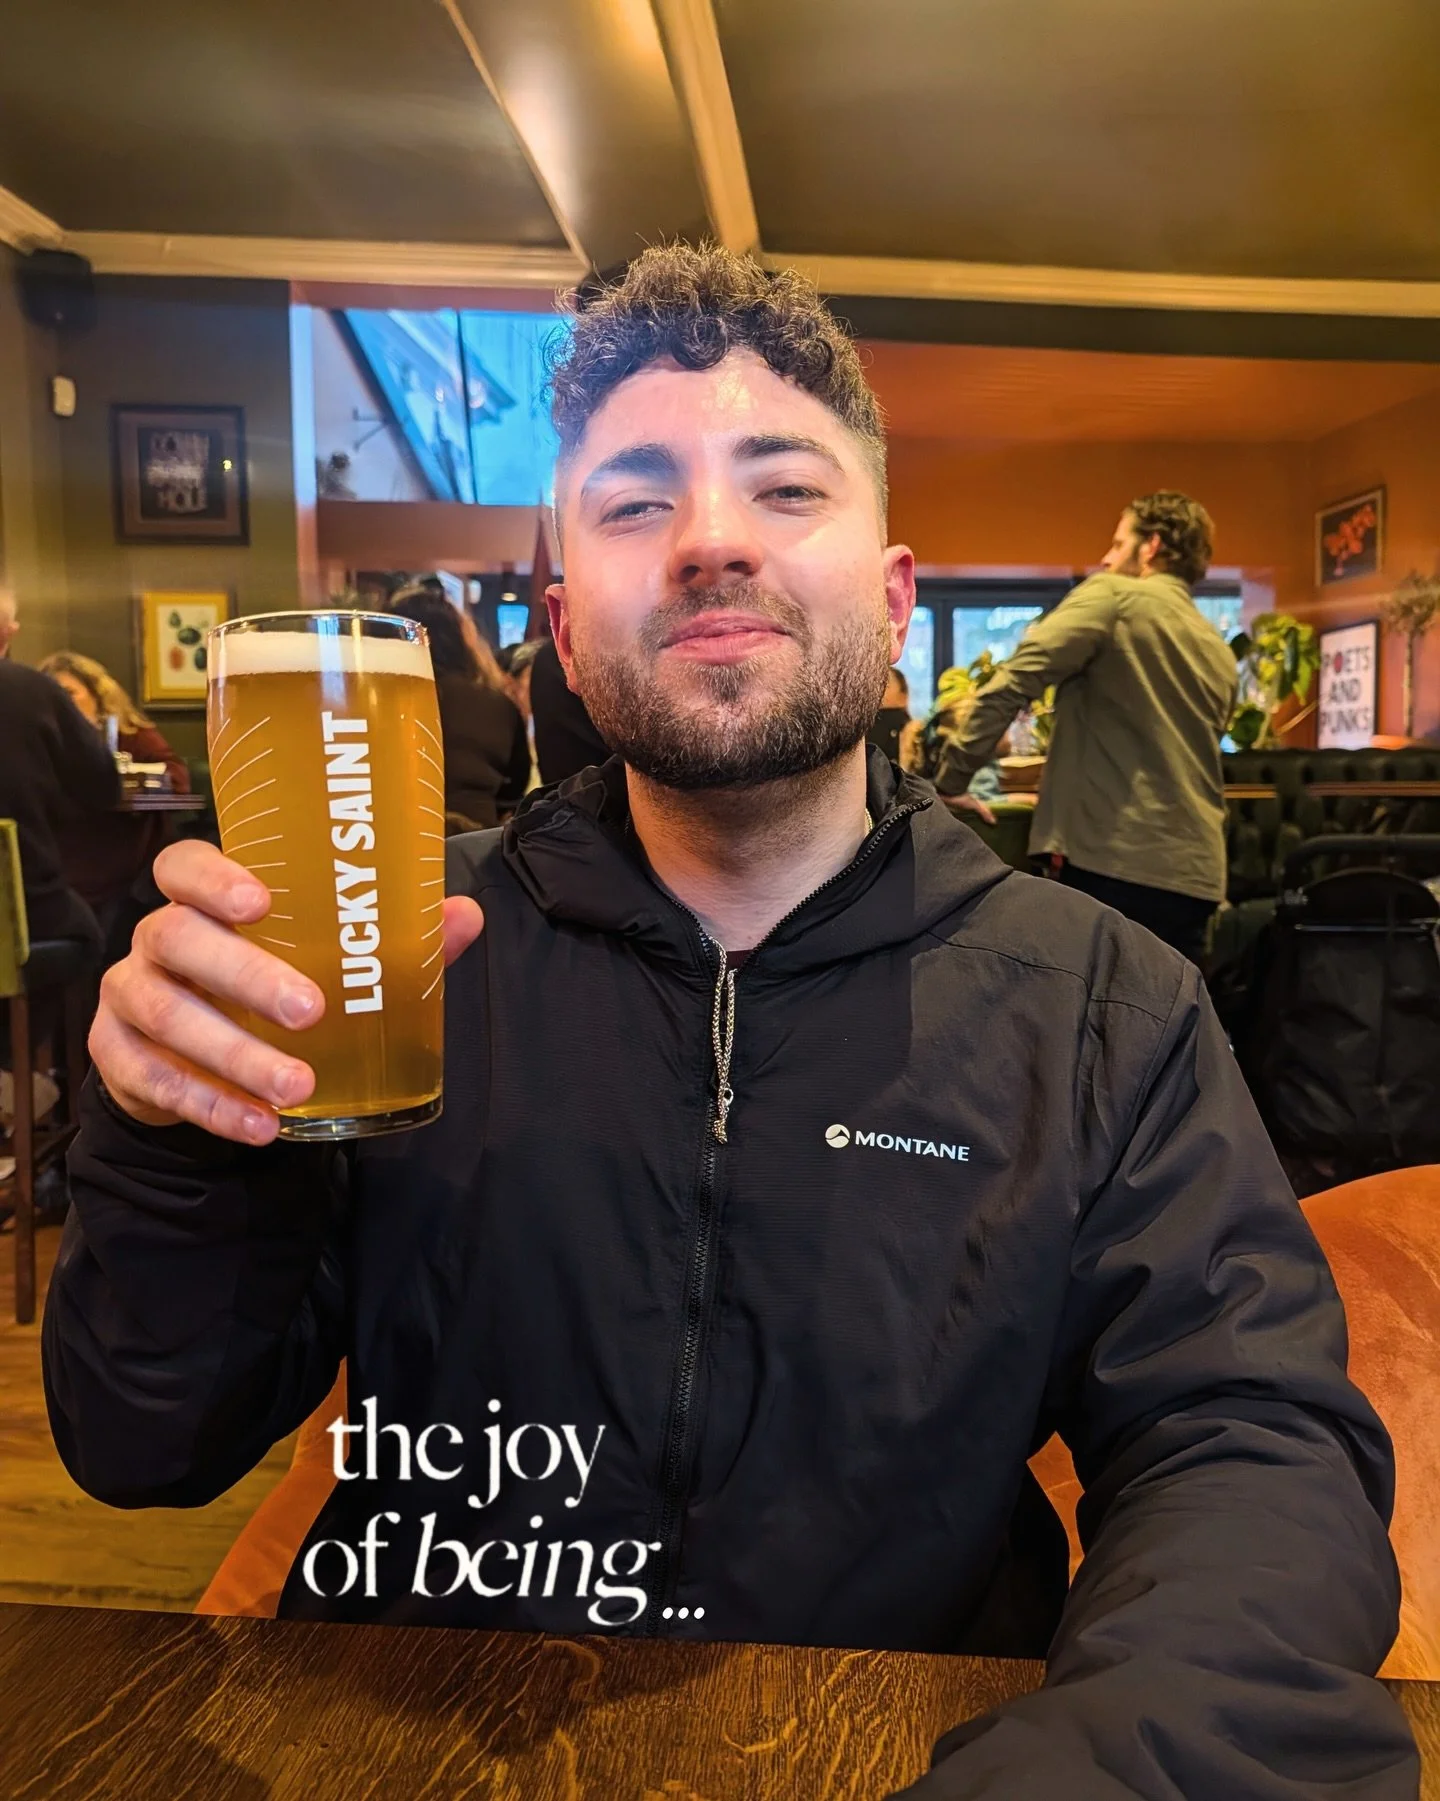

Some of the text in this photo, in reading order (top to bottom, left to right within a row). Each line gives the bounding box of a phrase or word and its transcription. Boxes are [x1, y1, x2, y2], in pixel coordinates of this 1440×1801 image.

[1329, 678, 1361, 703] AND
[1319, 707, 1371, 734] PUNKS
[321, 711, 383, 1014] LUCKY SAINT
[855, 1130, 970, 1162] MONTANE
